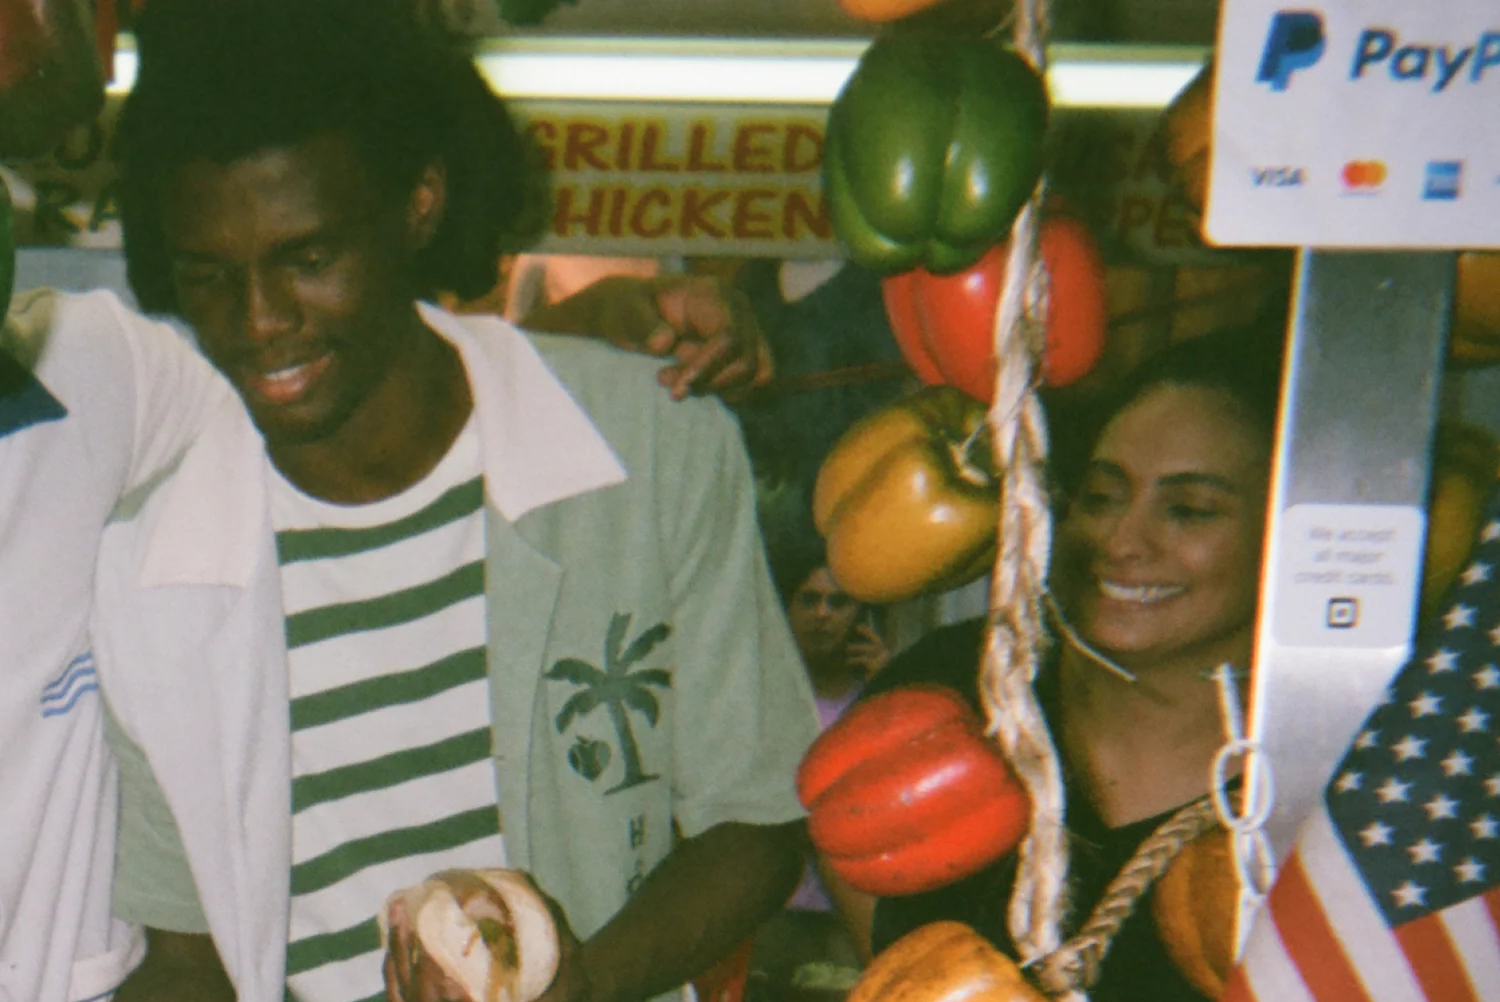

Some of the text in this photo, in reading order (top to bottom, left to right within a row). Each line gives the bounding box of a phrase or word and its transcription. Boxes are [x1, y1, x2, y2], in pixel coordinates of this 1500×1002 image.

[526, 118, 825, 173] GRILLED
[1252, 166, 1306, 187] VISA
[552, 186, 834, 240] HICKEN
